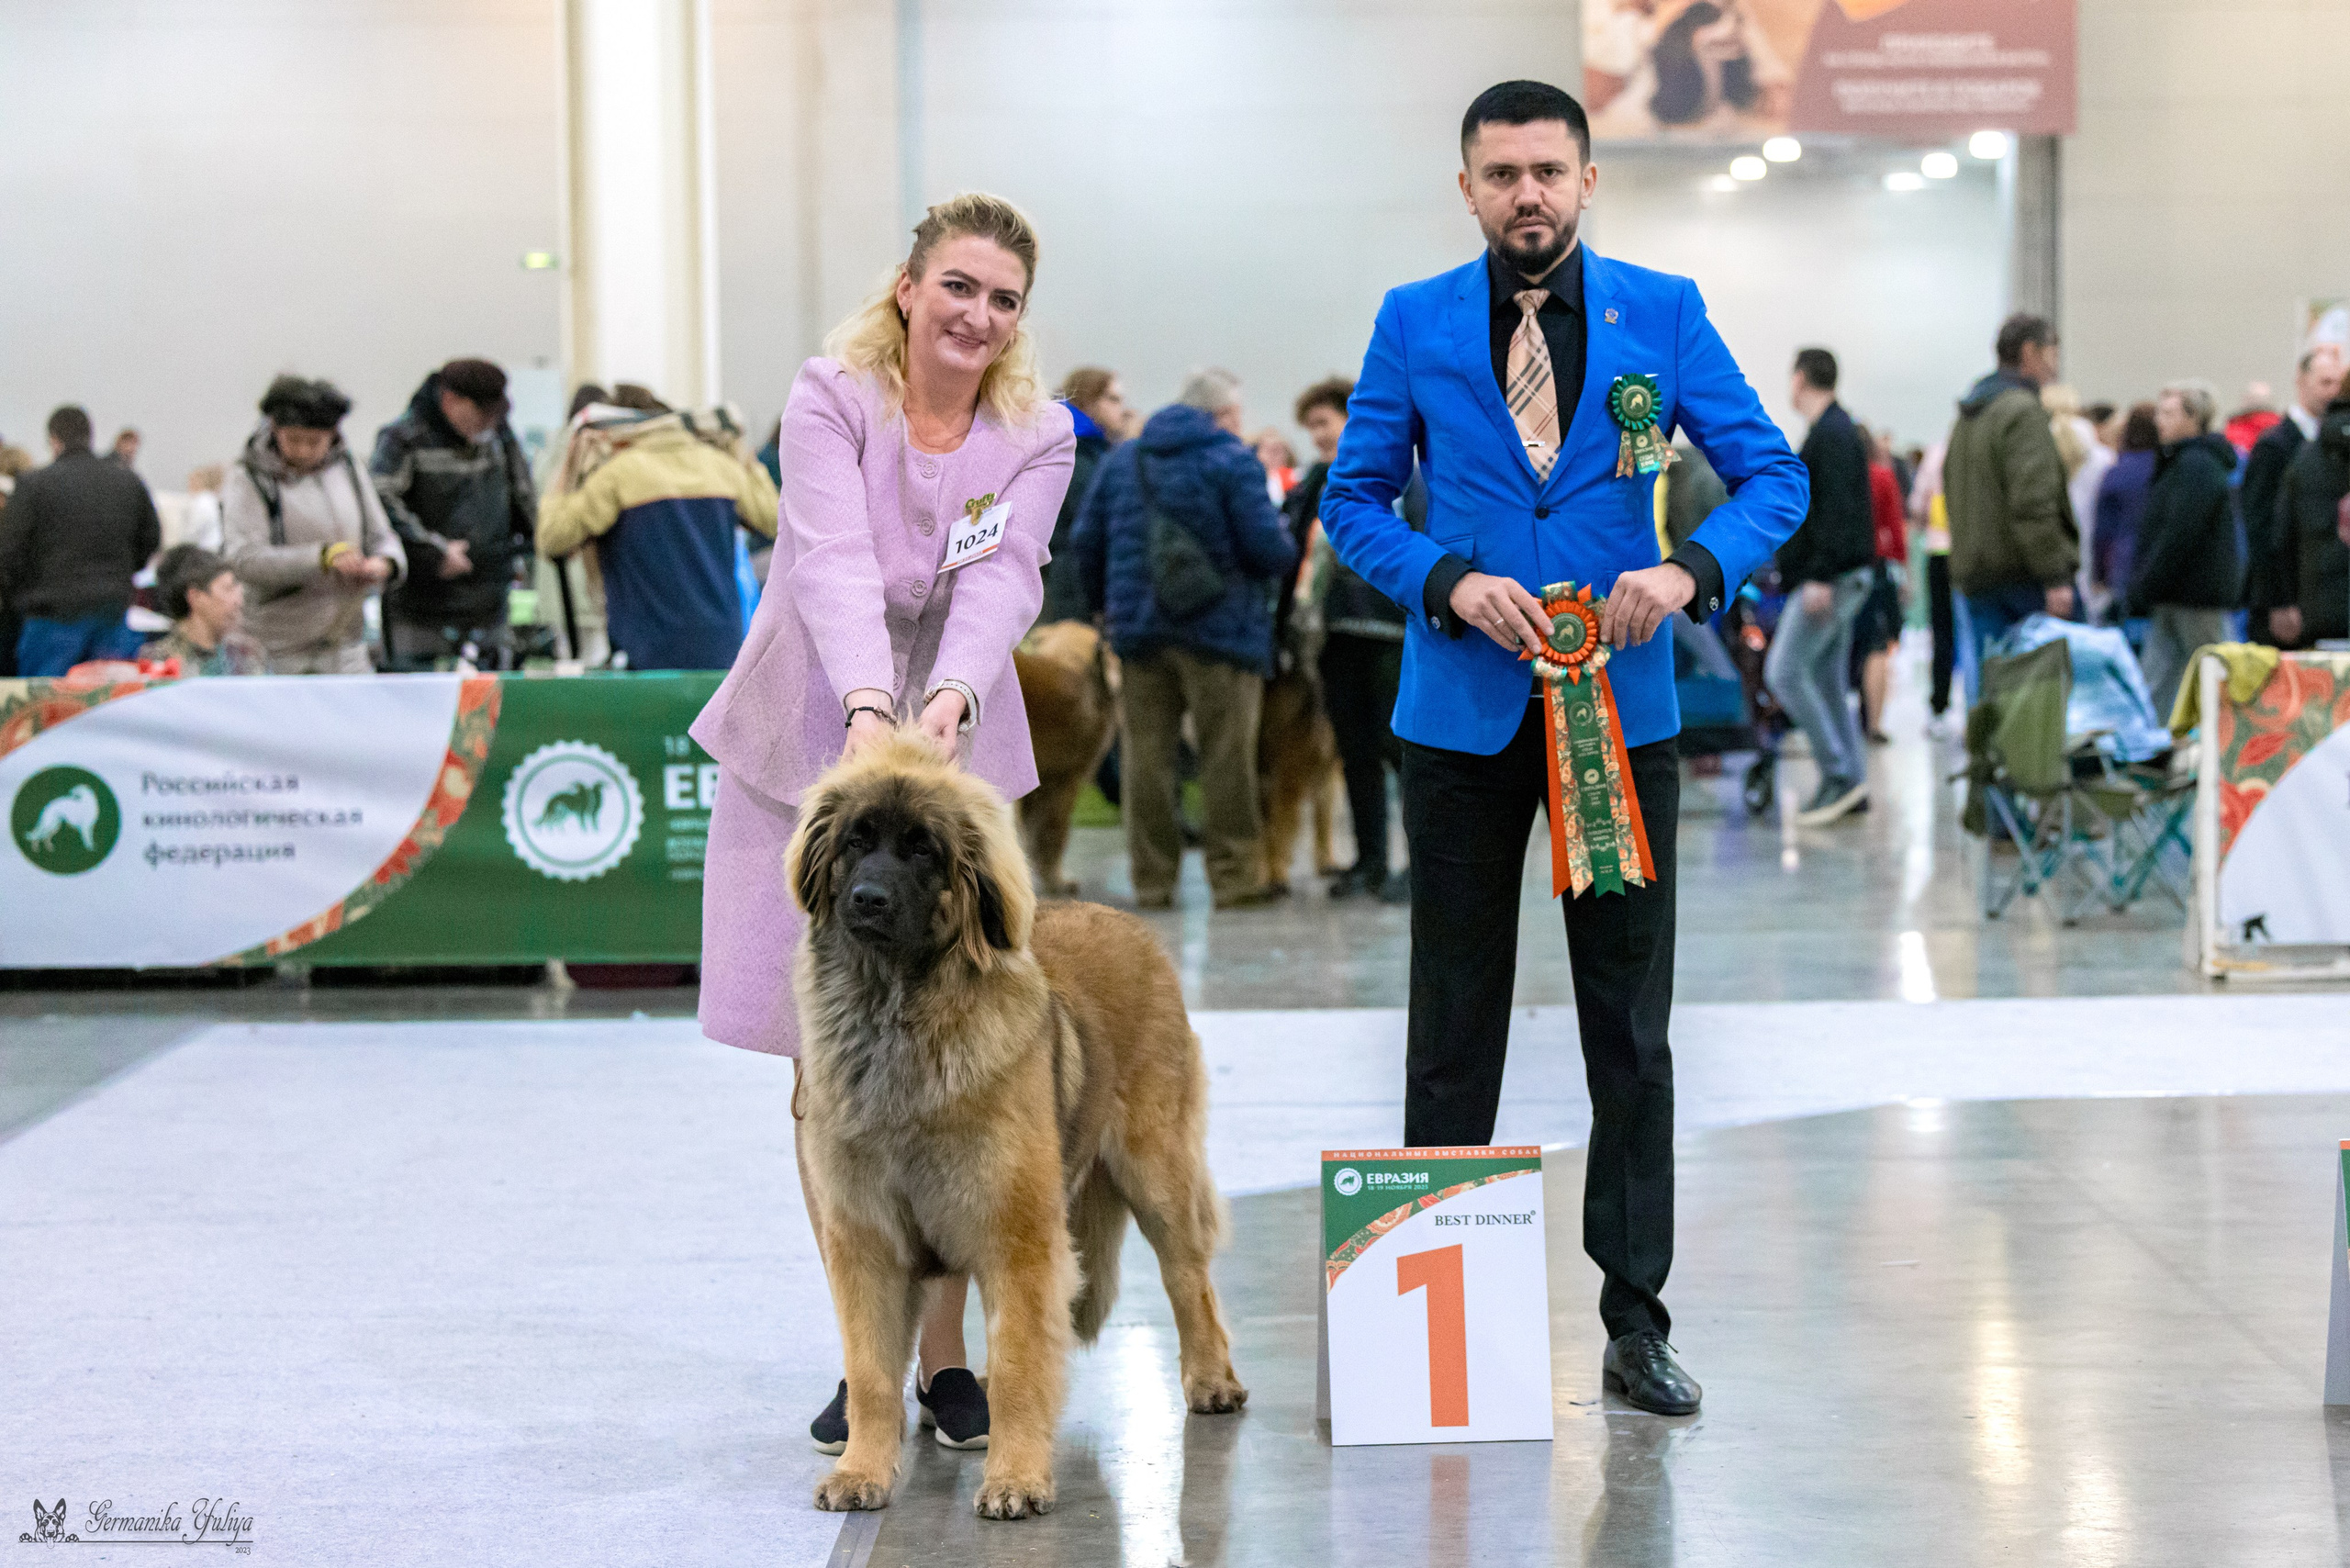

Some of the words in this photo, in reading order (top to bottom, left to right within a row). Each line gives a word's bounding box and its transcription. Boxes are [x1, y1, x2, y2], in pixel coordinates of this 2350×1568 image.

[956, 522, 999, 554] 1024
[141, 770, 300, 798] Российская
[141, 808, 364, 828] кинологическая
[142, 837, 297, 870] федерация
[1333, 1150, 1428, 1159] НАЦИОНАЛЬНЫЕ
[1434, 1148, 1495, 1157] ВЫСТАВКИ
[1501, 1148, 1539, 1156] СОБАК
[1366, 1172, 1429, 1184] ЕВРАЗИЯ
[1434, 1215, 1472, 1226] BEST
[1396, 1243, 1470, 1428] 1
